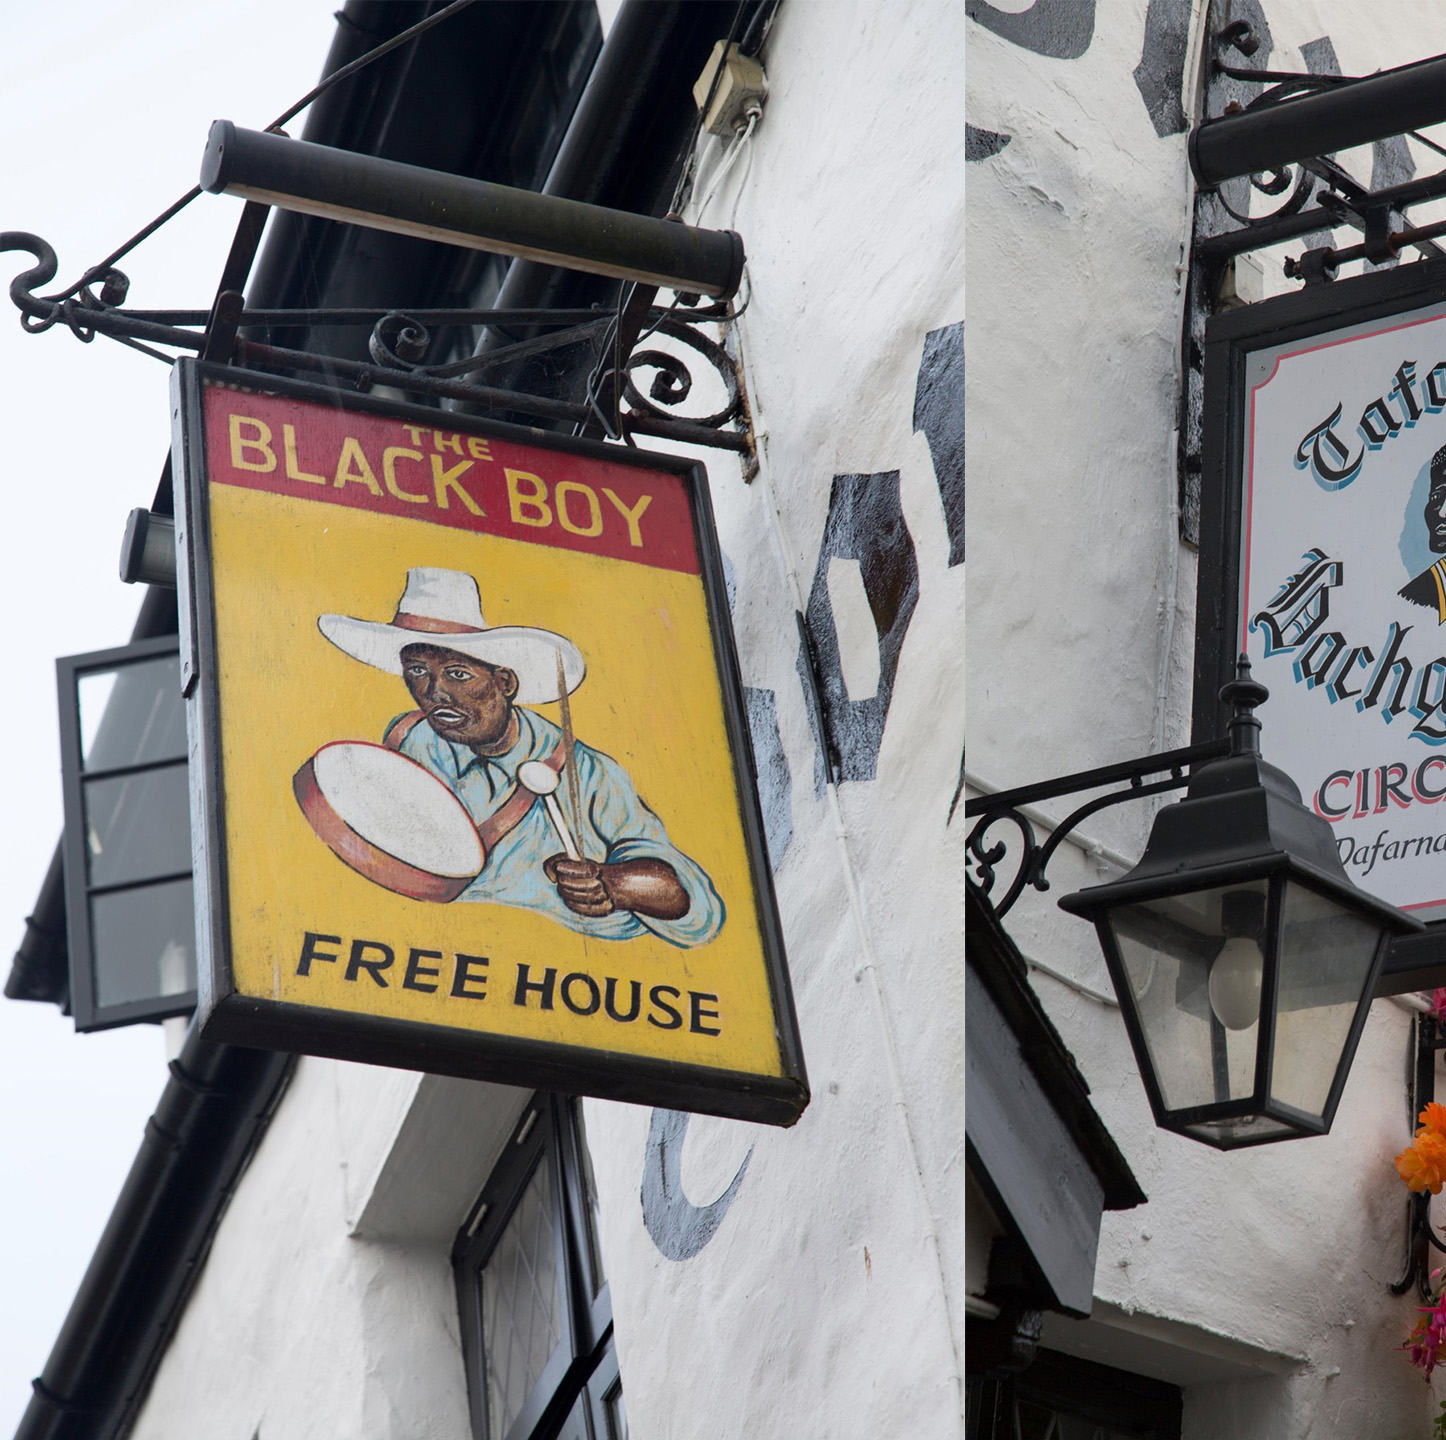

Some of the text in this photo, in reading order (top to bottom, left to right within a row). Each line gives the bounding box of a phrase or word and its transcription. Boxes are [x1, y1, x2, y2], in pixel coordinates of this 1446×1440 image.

[228, 413, 653, 548] BLACK BOY
[402, 424, 494, 462] THE
[296, 931, 723, 1037] FREE HOUSE
